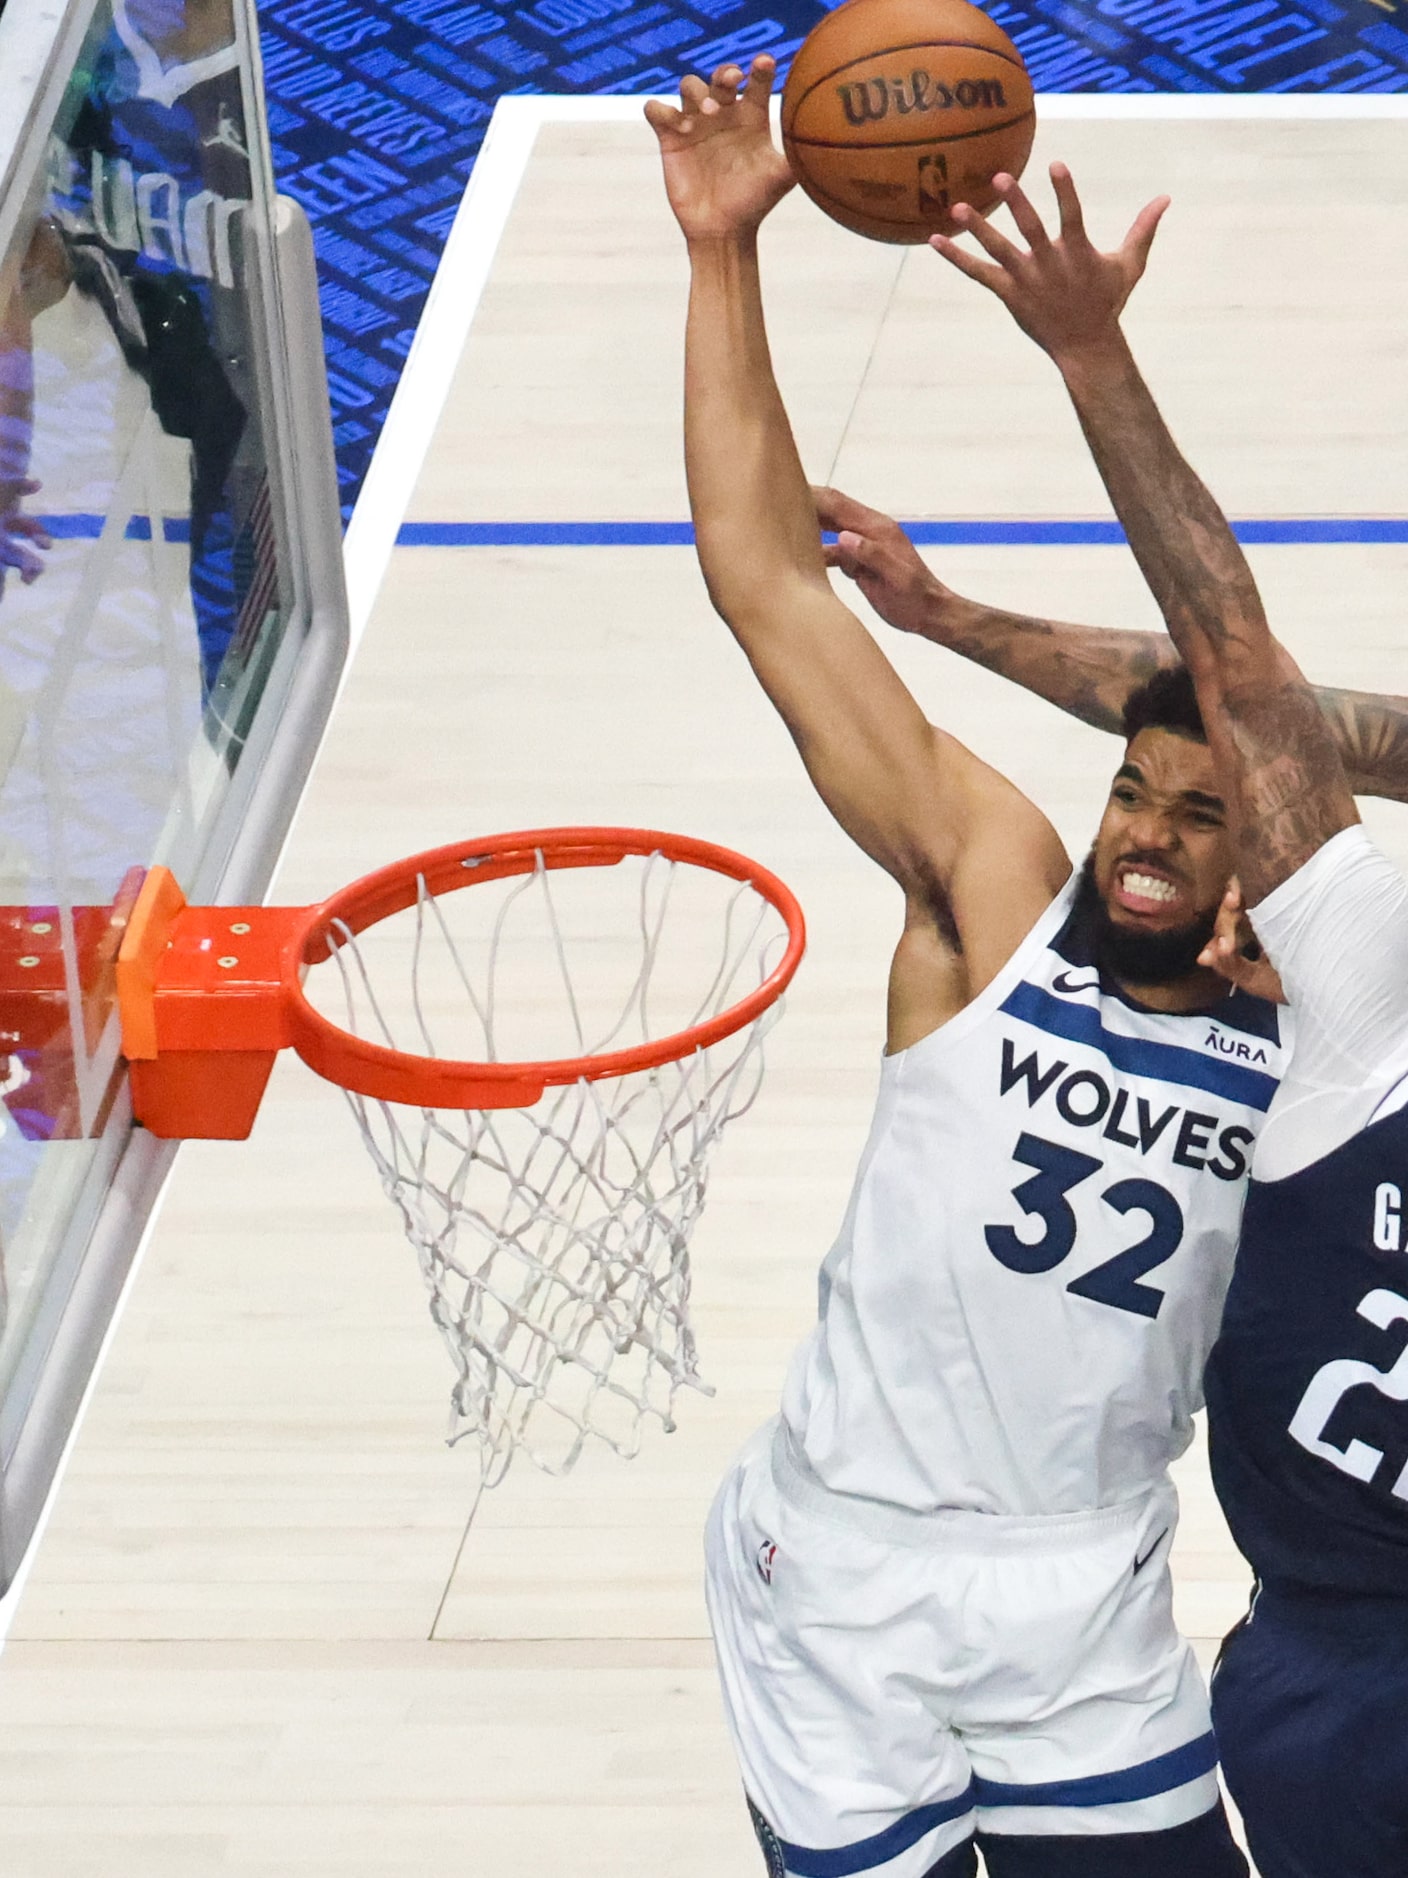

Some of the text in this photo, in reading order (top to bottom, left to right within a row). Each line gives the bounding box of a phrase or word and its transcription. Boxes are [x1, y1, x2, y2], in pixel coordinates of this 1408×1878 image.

[260, 31, 344, 99] ALID
[838, 69, 1008, 127] Wilson
[300, 80, 447, 156] REEVES
[275, 148, 409, 223] EEN
[999, 1038, 1256, 1182] WOLVES
[984, 1131, 1184, 1320] 32
